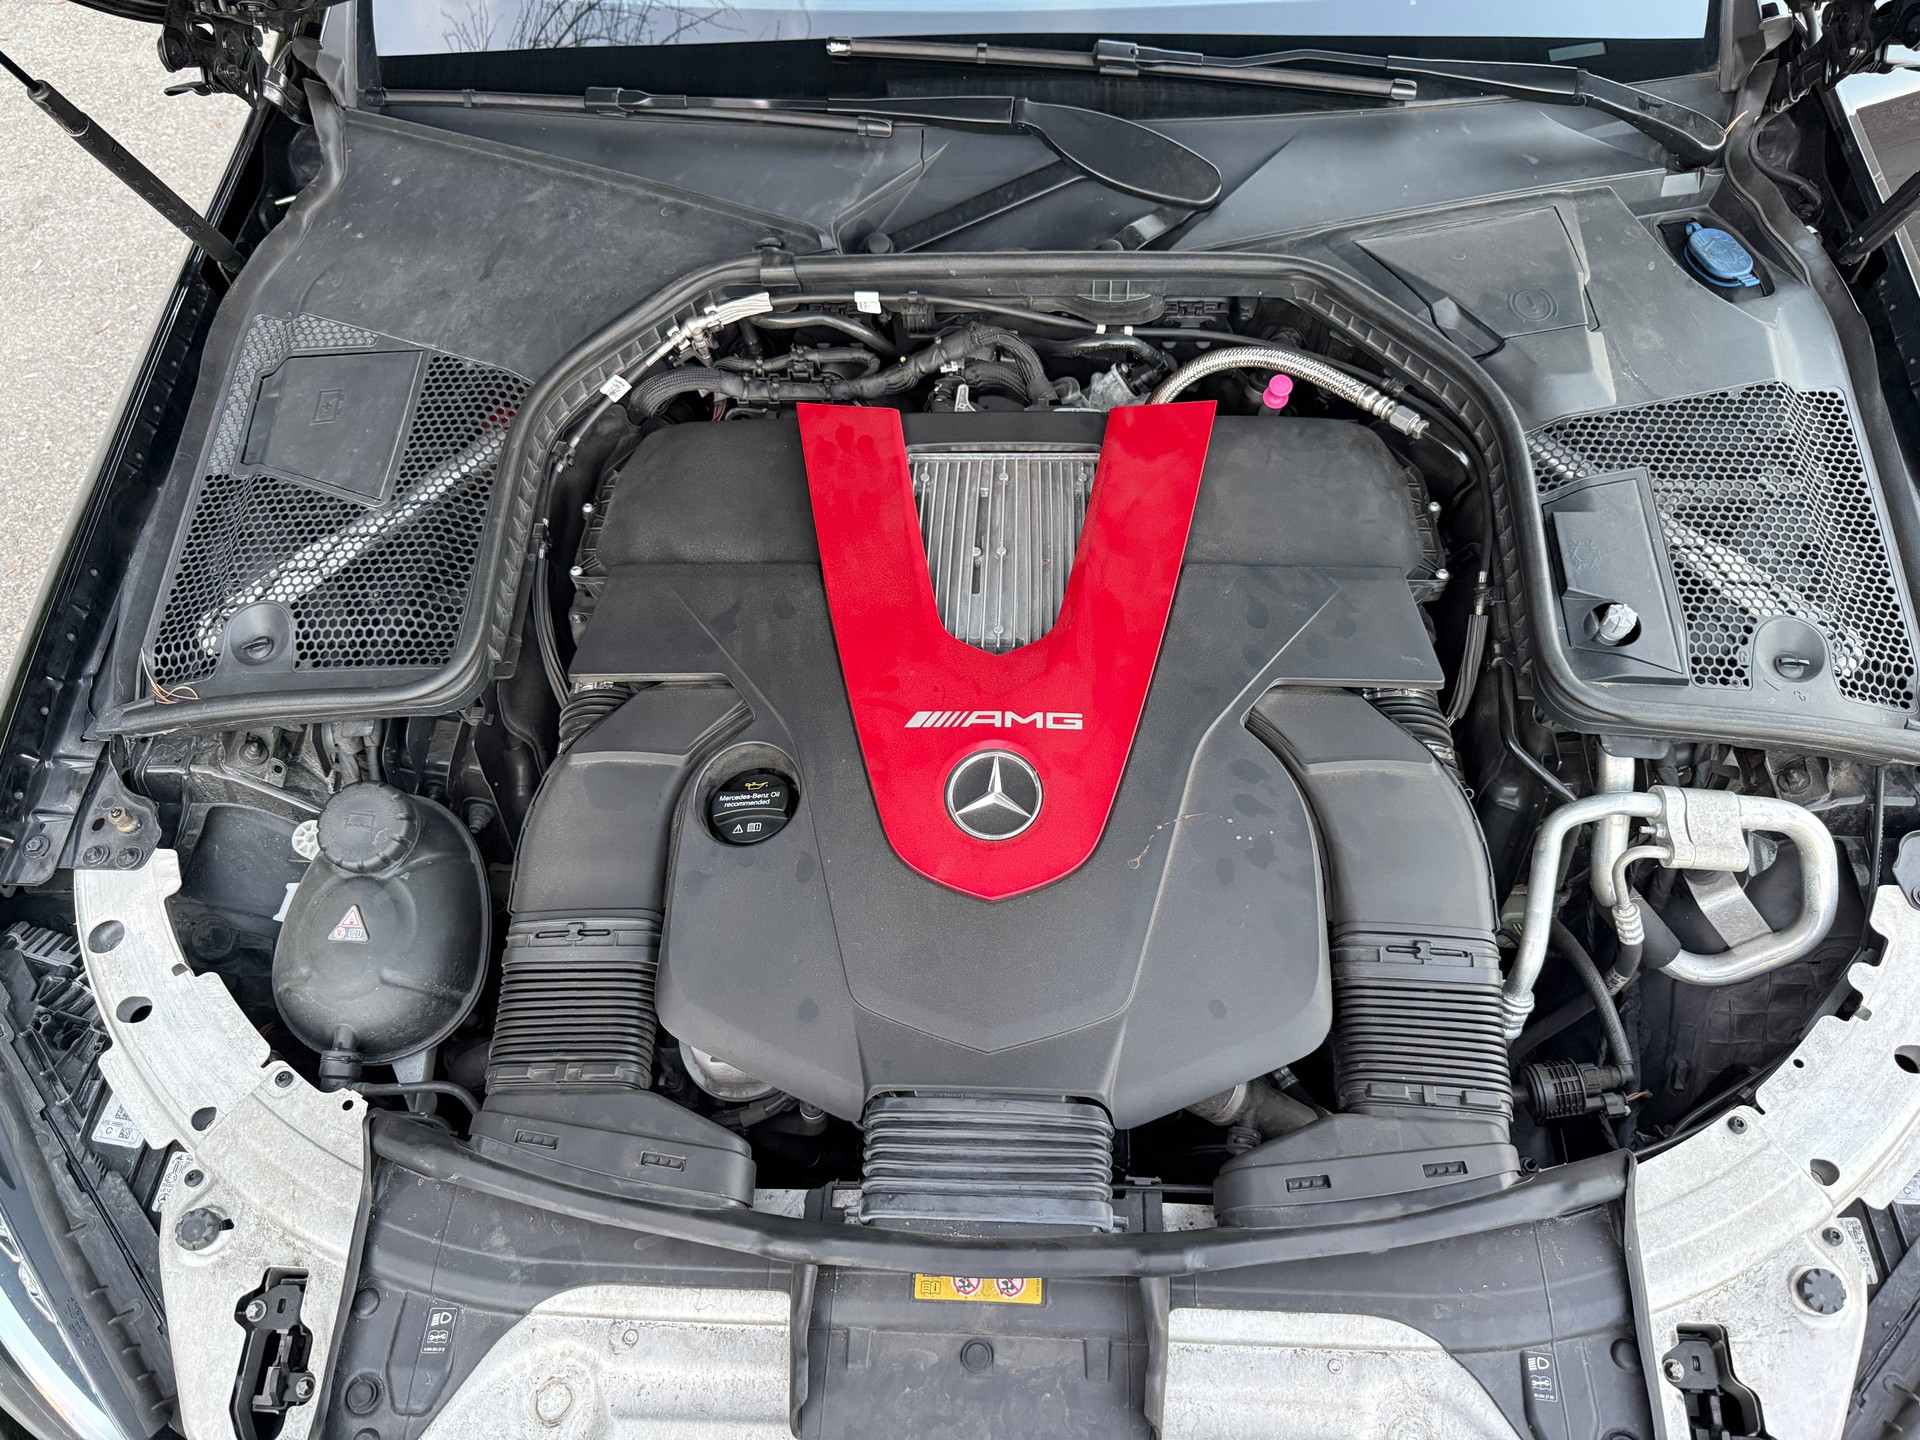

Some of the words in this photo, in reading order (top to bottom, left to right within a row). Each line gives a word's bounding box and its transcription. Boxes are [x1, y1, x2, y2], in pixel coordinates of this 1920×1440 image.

[961, 711, 1083, 730] AMG
[719, 793, 769, 801] Mercedes-Benz
[723, 799, 770, 807] recommended
